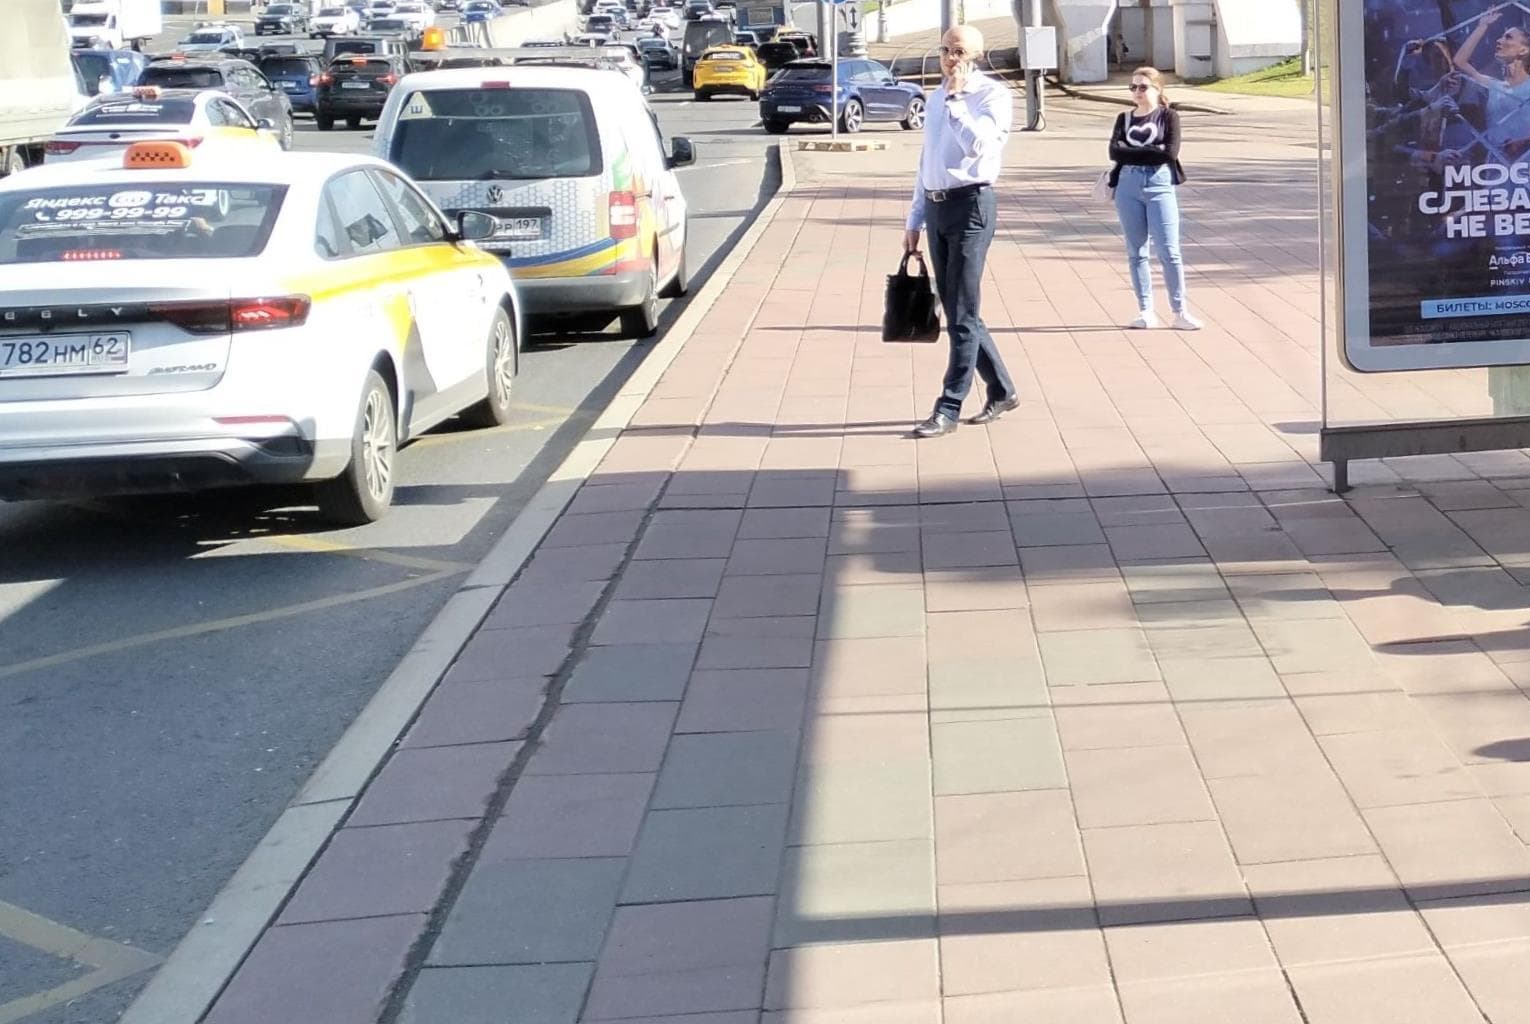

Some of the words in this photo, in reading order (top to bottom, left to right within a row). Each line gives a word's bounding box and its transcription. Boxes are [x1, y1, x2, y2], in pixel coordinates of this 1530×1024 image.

[24, 195, 106, 210] Яндекс
[55, 206, 187, 221] 999-99-99
[516, 219, 537, 230] 197
[1447, 215, 1487, 239] НЕ
[4, 307, 123, 321] EELY
[1436, 302, 1492, 314] БИЛЕТЫ:
[2, 342, 86, 366] 782НМ
[93, 337, 119, 355] 62
